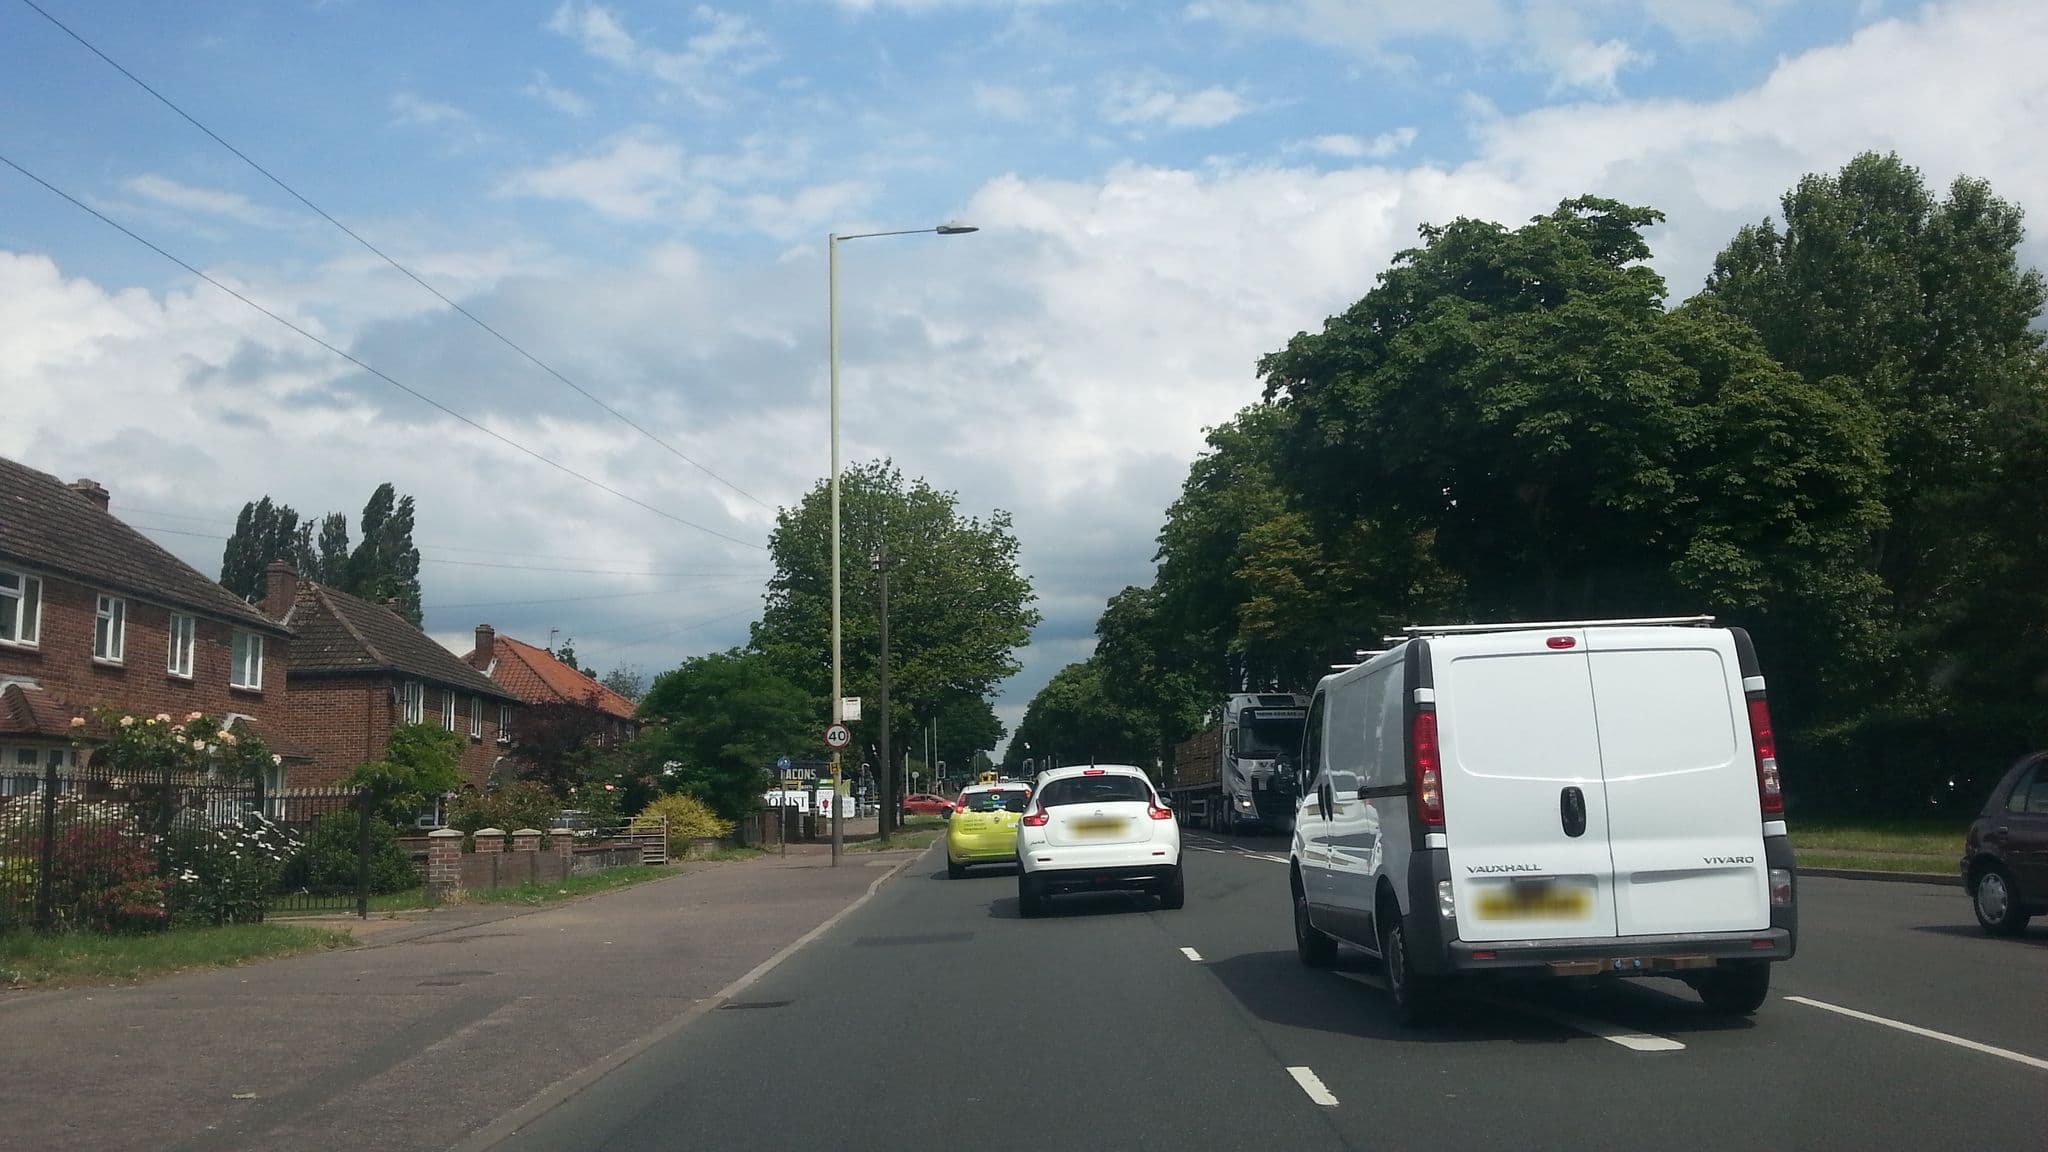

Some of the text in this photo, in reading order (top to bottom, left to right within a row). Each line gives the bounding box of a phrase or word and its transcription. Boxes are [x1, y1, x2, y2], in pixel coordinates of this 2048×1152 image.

[829, 731, 846, 741] 40
[1703, 855, 1755, 865] VIVARO
[1466, 864, 1543, 874] VAUXHALL
